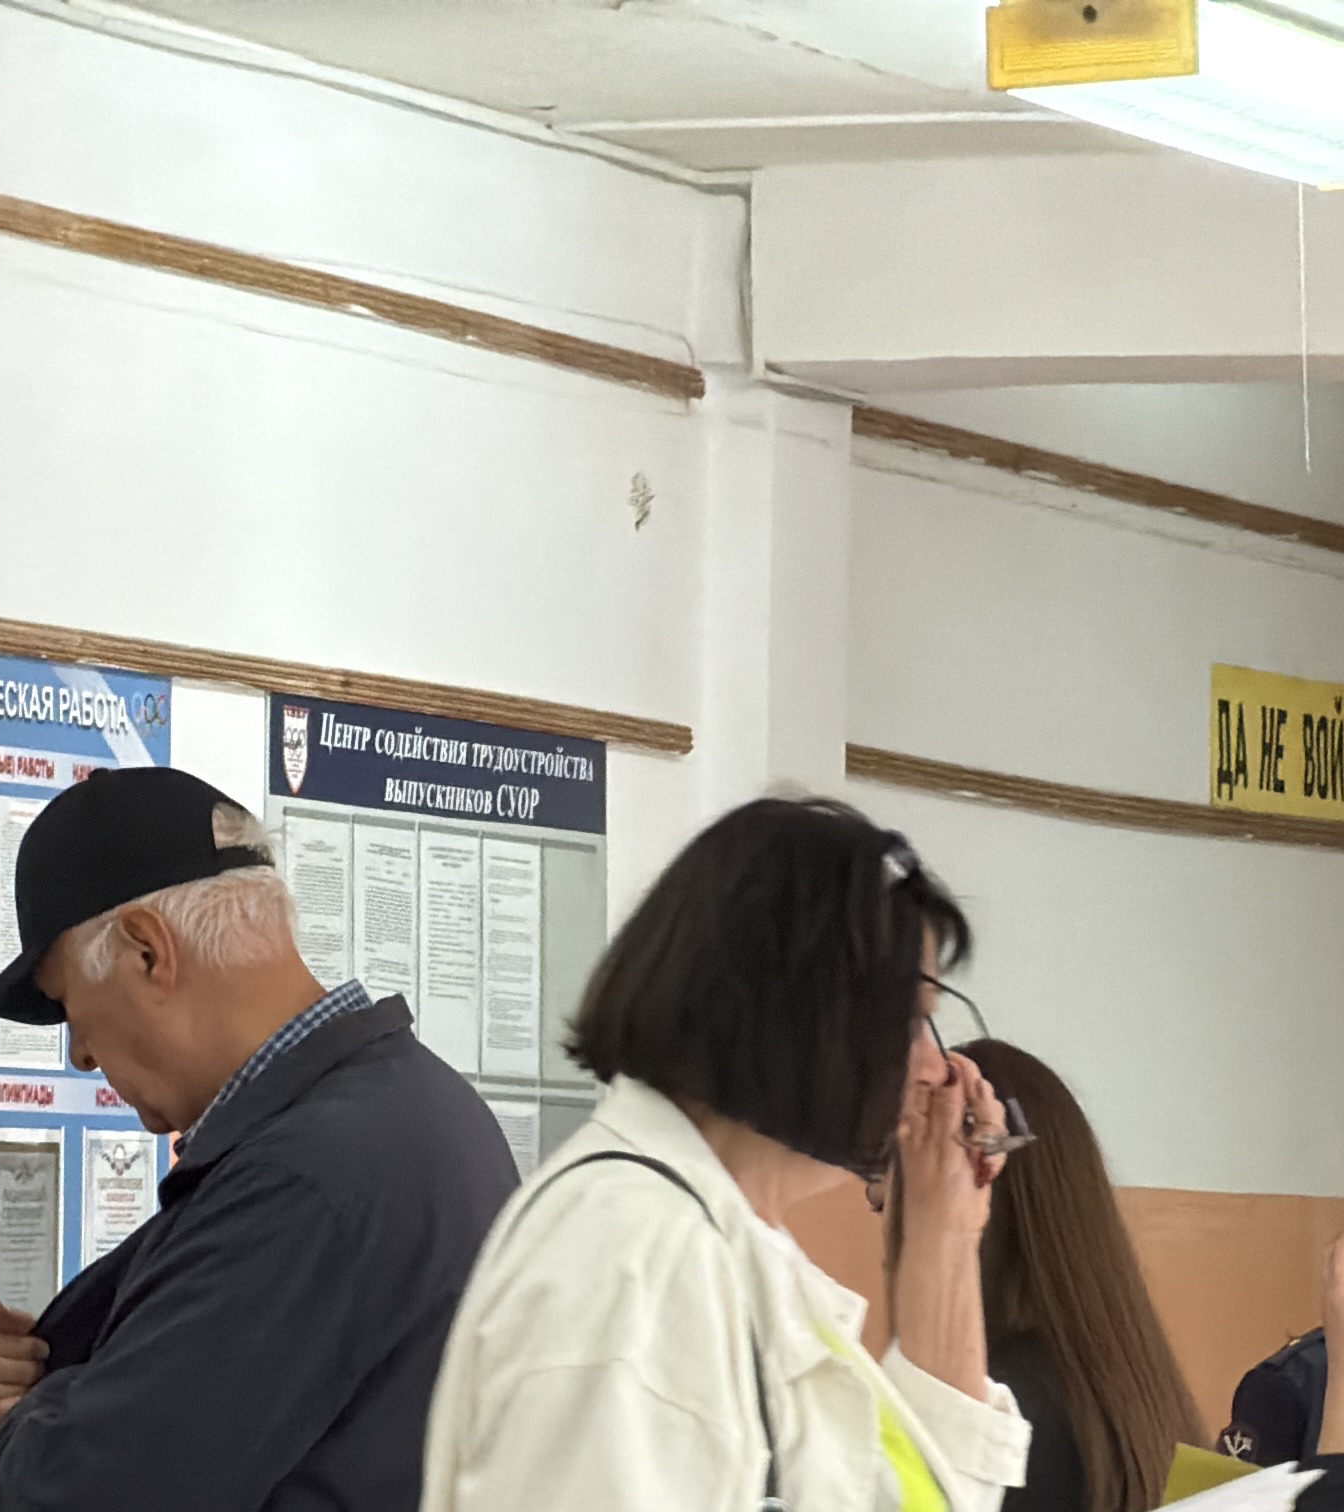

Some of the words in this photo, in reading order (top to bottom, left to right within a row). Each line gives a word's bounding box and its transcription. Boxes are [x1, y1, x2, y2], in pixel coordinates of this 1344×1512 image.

[59, 685, 129, 732] РАБОТА
[17, 757, 56, 780] РАБОТЫ
[1217, 698, 1248, 801] ДА
[1259, 705, 1288, 794] НЕ
[496, 784, 540, 819] СУОР
